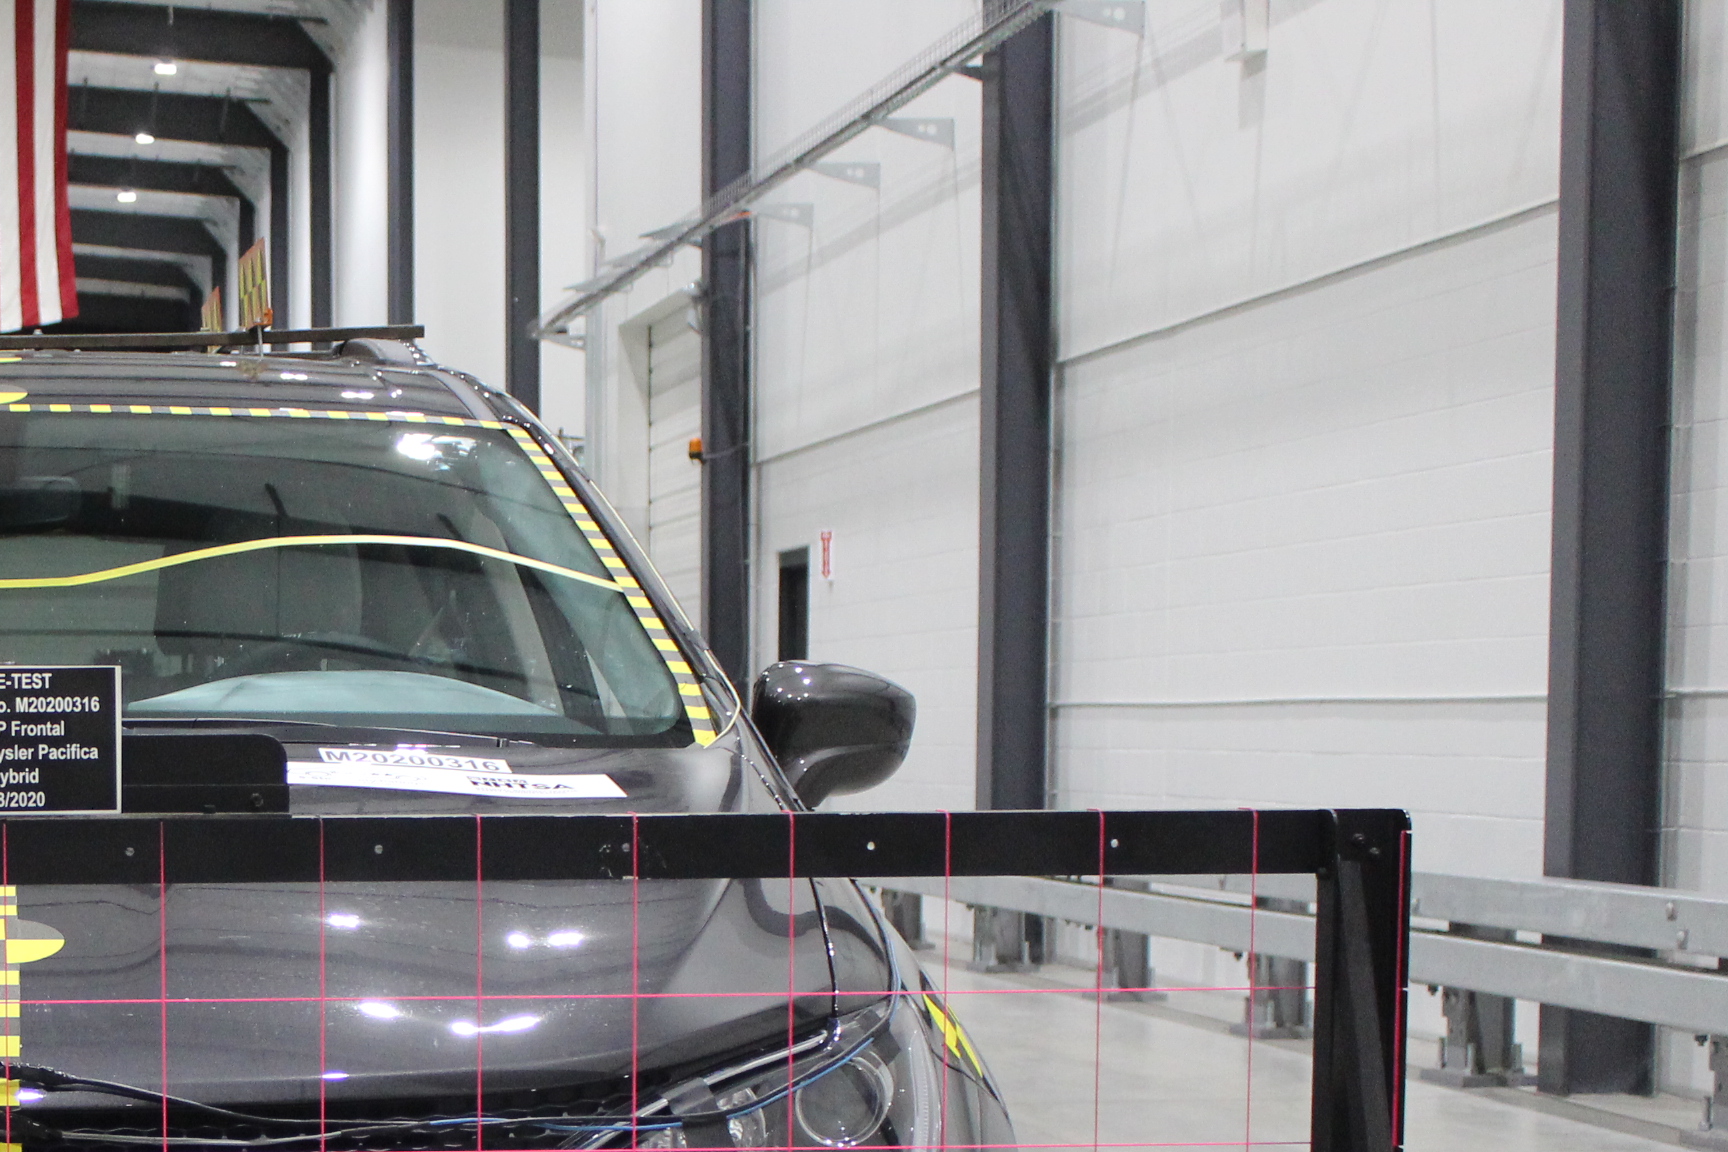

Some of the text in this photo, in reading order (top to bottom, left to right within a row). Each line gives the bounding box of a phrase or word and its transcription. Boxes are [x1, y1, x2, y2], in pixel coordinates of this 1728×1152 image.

[15, 696, 100, 713] M20200316
[11, 720, 65, 736] Frontal
[38, 744, 99, 760] Pacifica
[325, 751, 500, 771] M20200316
